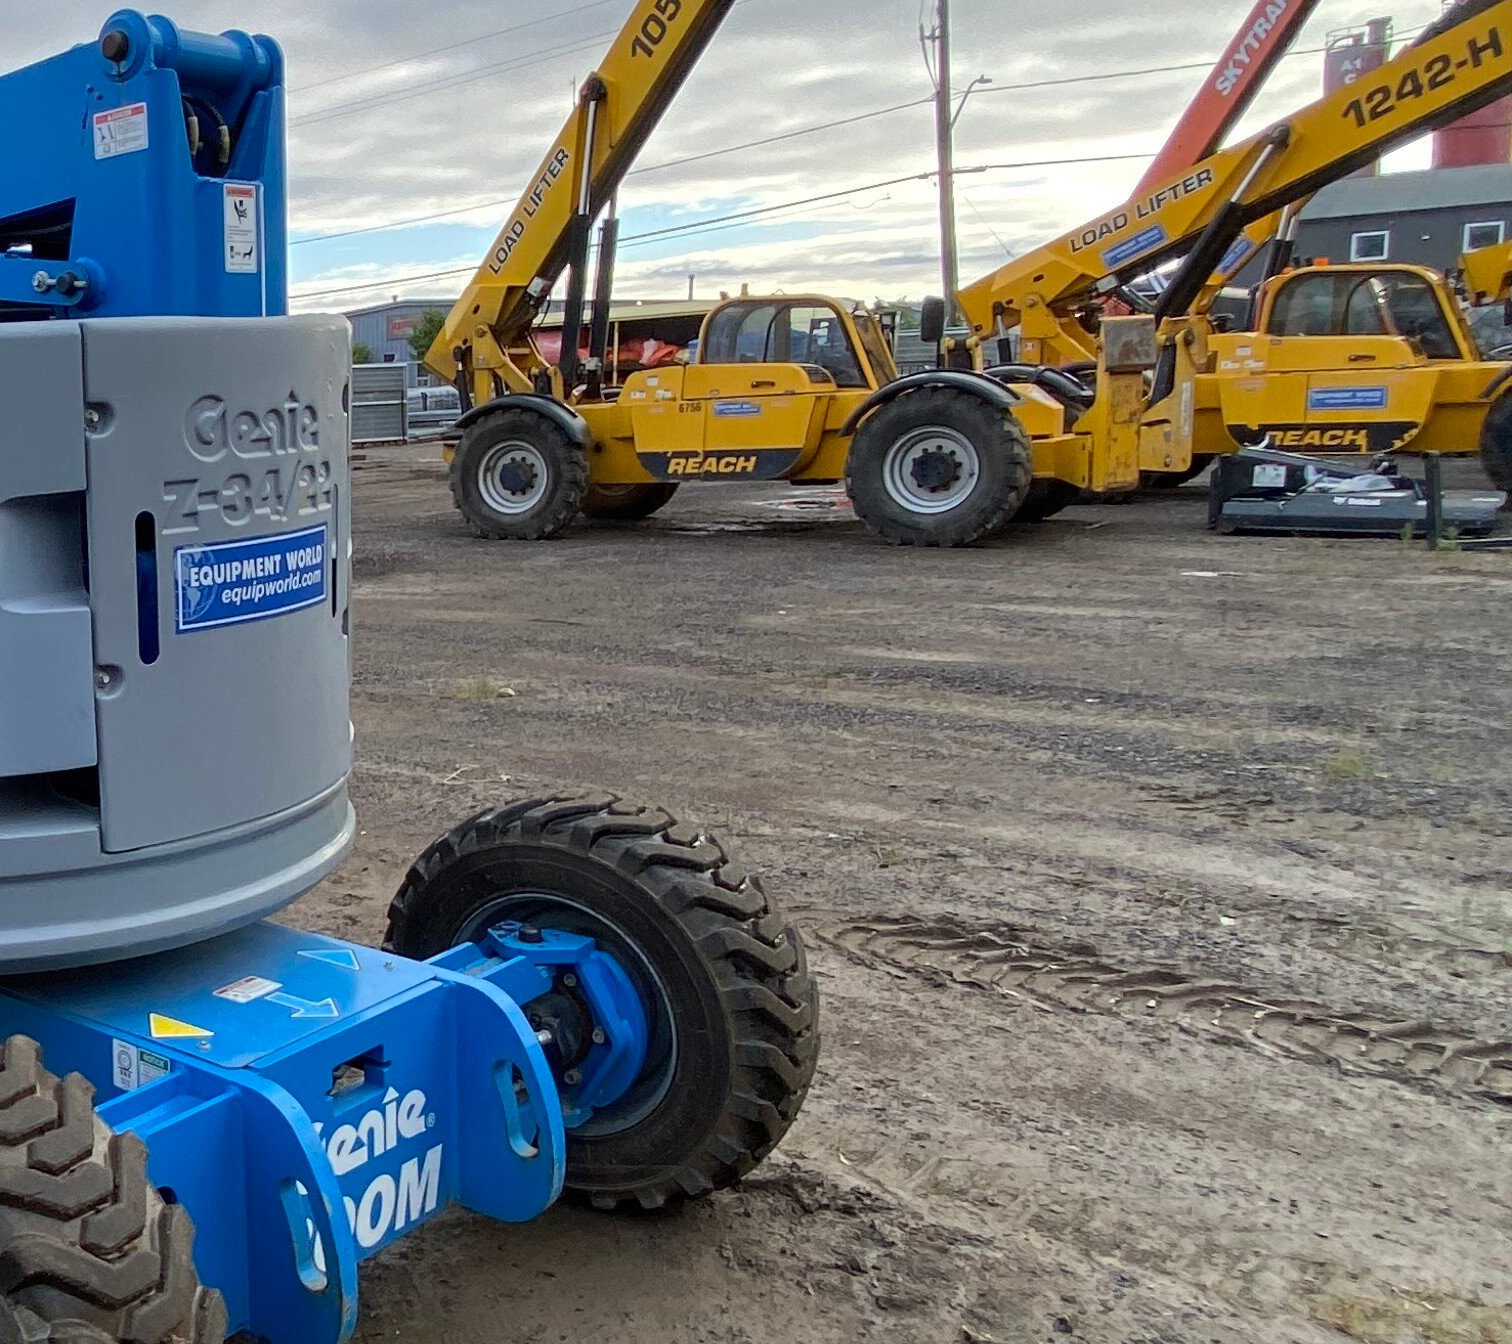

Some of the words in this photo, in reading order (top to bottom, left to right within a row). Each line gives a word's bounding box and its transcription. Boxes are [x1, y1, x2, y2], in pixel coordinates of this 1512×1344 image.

[1341, 26, 1503, 127] 1242-H
[488, 220, 525, 275] LOAD
[523, 148, 569, 218] LIFTER
[1070, 212, 1128, 253] LOAD
[1136, 168, 1213, 219] LIFTER
[183, 390, 320, 463] Genie
[162, 460, 332, 535] Z-34/22
[667, 456, 757, 476] REACH
[190, 554, 282, 587] EQUIPMENT
[286, 545, 323, 571] WORLD
[221, 569, 322, 606] equipworld.com
[312, 1086, 428, 1176] enie
